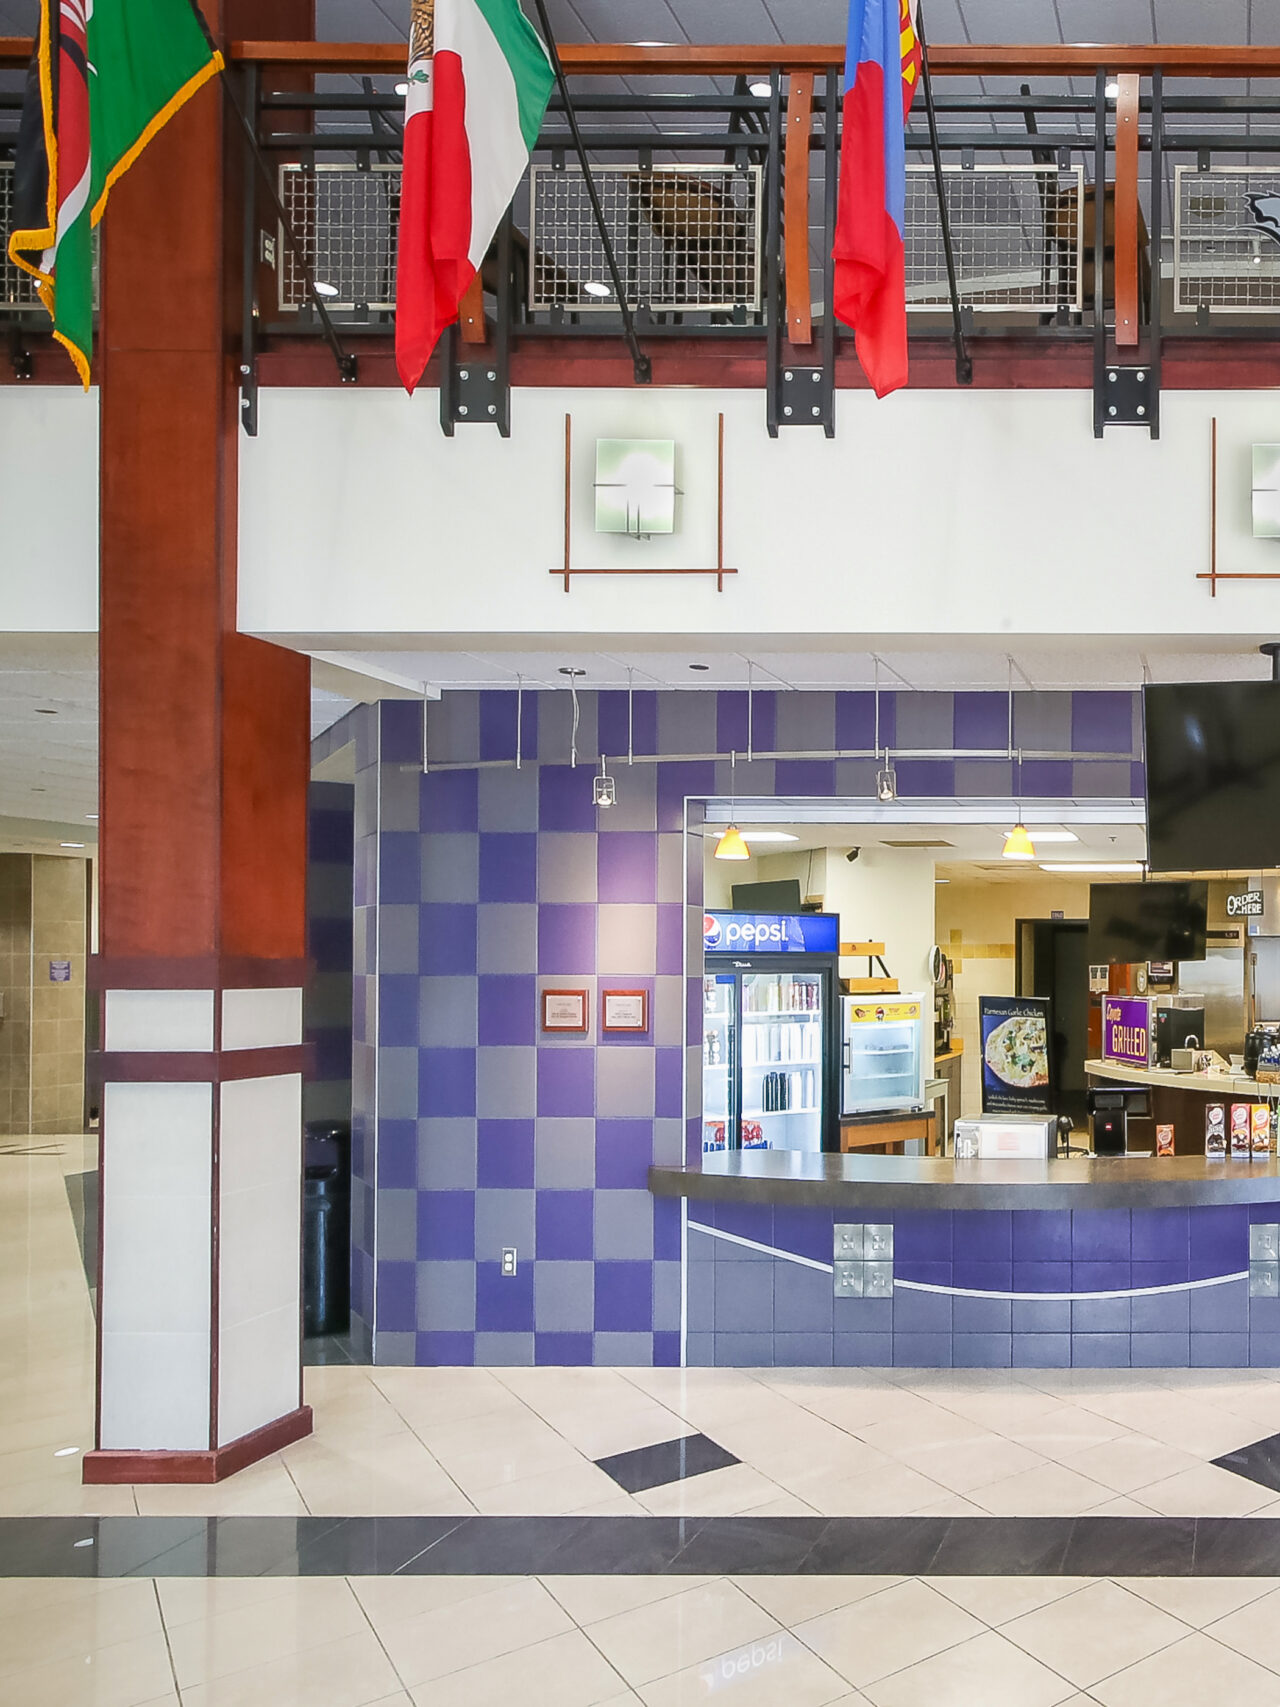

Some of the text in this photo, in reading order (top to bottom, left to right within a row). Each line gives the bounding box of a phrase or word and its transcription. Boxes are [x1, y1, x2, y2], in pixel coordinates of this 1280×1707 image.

[1227, 892, 1261, 915] ORDER
[1241, 903, 1262, 914] HERE
[726, 919, 785, 946] pepsi
[984, 1007, 1007, 1015] Parmesan
[1022, 1008, 1044, 1017] Chicken
[1112, 1024, 1146, 1057] GRILLED
